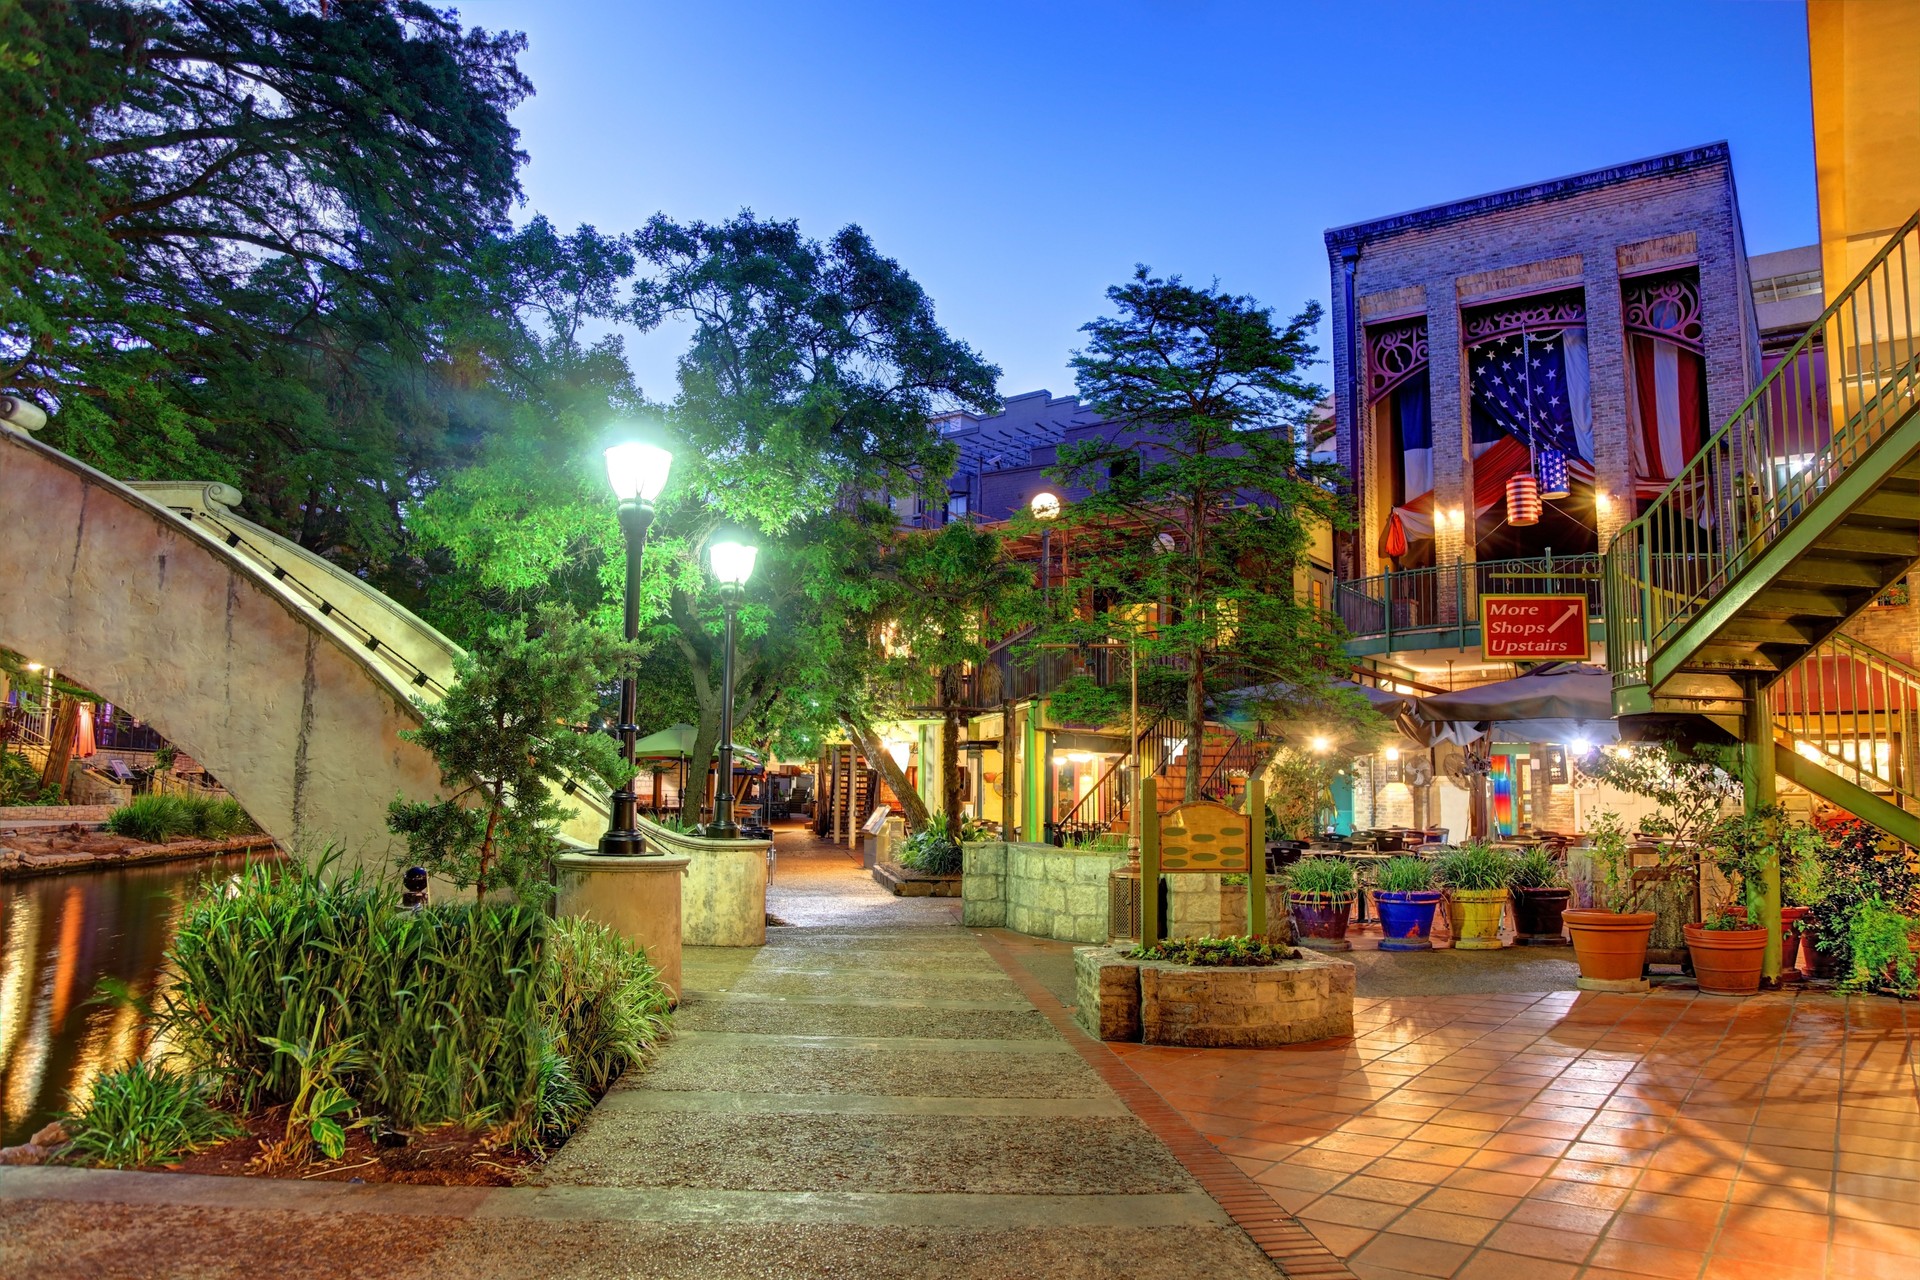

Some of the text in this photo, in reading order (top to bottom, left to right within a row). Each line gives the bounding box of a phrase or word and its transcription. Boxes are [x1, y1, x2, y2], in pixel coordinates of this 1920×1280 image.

[1490, 603, 1539, 616] More
[1490, 621, 1545, 636] Shops
[1491, 639, 1568, 655] Upstairs
